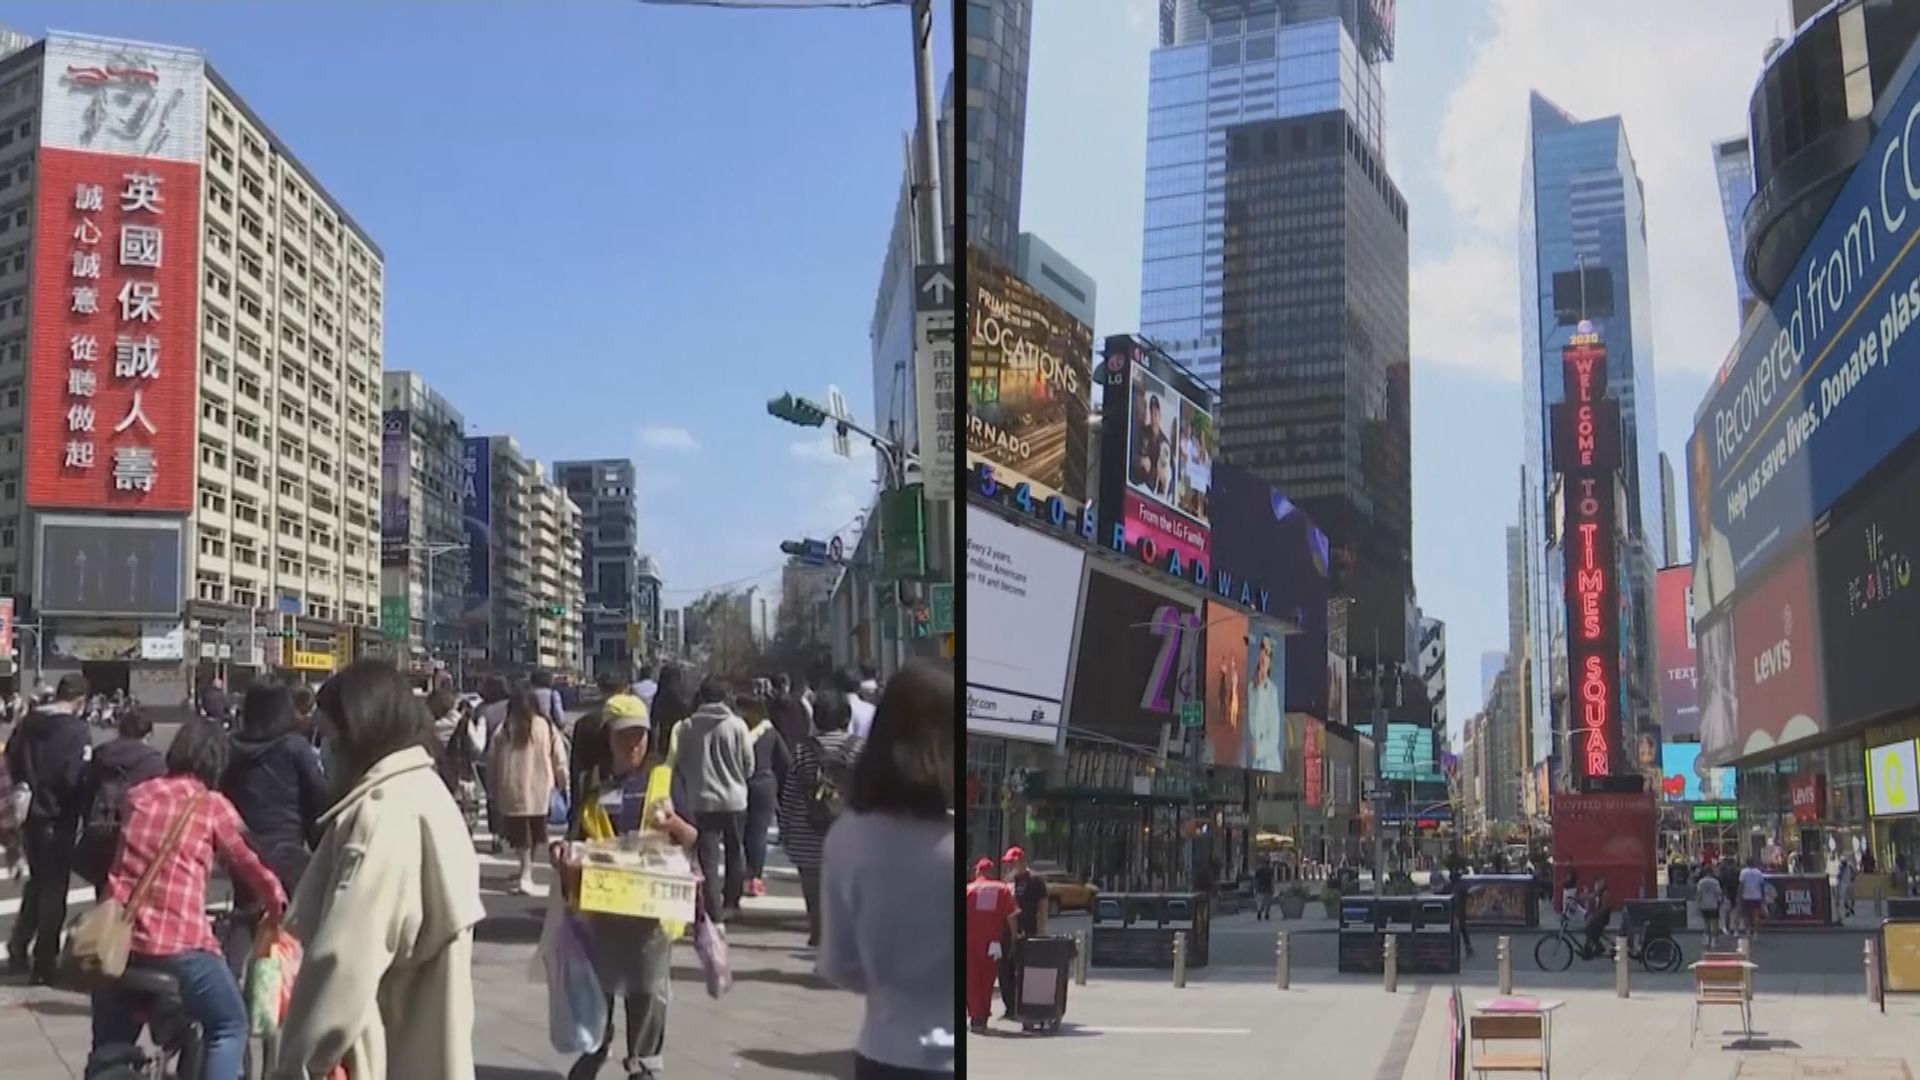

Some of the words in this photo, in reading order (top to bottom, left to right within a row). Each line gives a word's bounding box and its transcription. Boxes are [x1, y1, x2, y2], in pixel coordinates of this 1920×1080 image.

[70, 183, 103, 314] 誠心誠意
[111, 170, 164, 494] 英國保誠人壽
[976, 309, 1077, 393] LOCATIONS
[978, 286, 1011, 323] PRIME
[1715, 283, 1805, 468] Recovered
[1807, 205, 1875, 340] from
[65, 334, 98, 469] 從聽做起
[1107, 373, 1123, 385] LG
[1575, 359, 1594, 466] WELCOME
[1727, 479, 1748, 525] Help
[1748, 468, 1760, 501] us
[1761, 437, 1786, 488] save
[1786, 402, 1820, 459] lives.
[1820, 330, 1877, 419] Donate
[1880, 275, 1920, 368] plas
[967, 413, 1031, 459] RNADO
[1139, 503, 1159, 524] From
[1159, 514, 1172, 533] the
[1172, 520, 1183, 539] LG
[1183, 526, 1205, 550] Family
[1580, 479, 1599, 516] TO
[1578, 523, 1603, 639] TIMES
[1583, 655, 1609, 776] SQUAR
